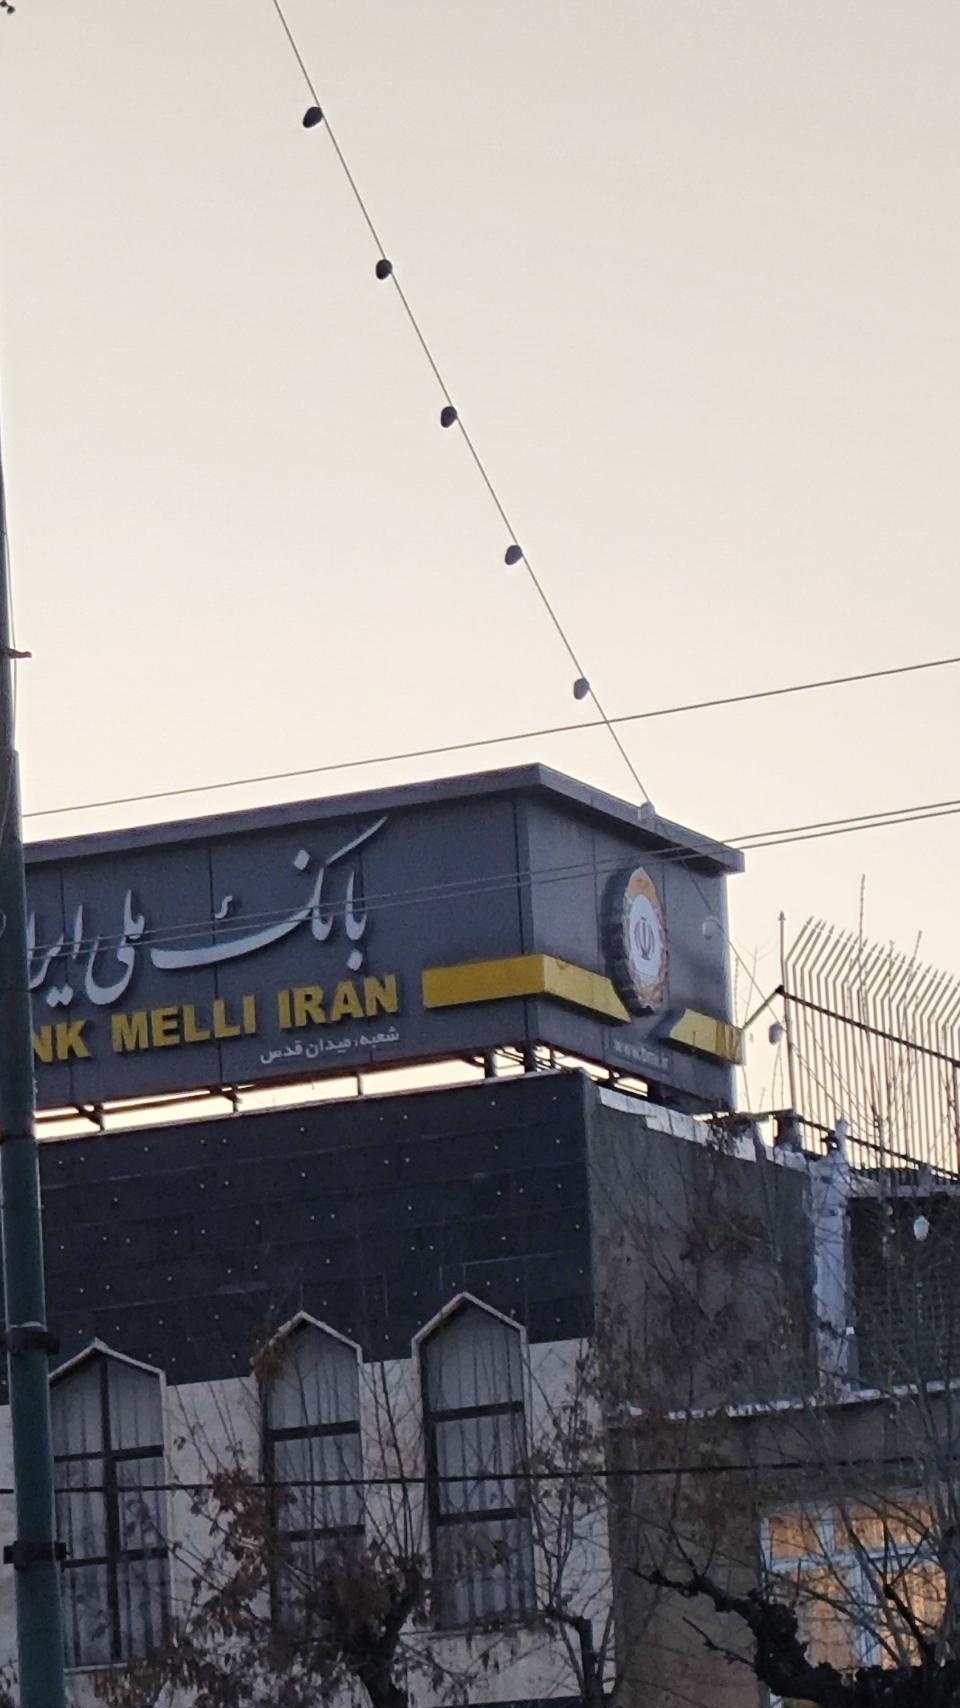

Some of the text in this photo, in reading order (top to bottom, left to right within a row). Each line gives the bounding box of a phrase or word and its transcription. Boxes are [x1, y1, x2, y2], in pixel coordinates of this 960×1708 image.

[85, 890, 145, 1006] ملی
[112, 994, 257, 1053] MELLI
[278, 973, 399, 1030] IRAN
[259, 1040, 304, 1065] قدس
[305, 1038, 352, 1059] میدان
